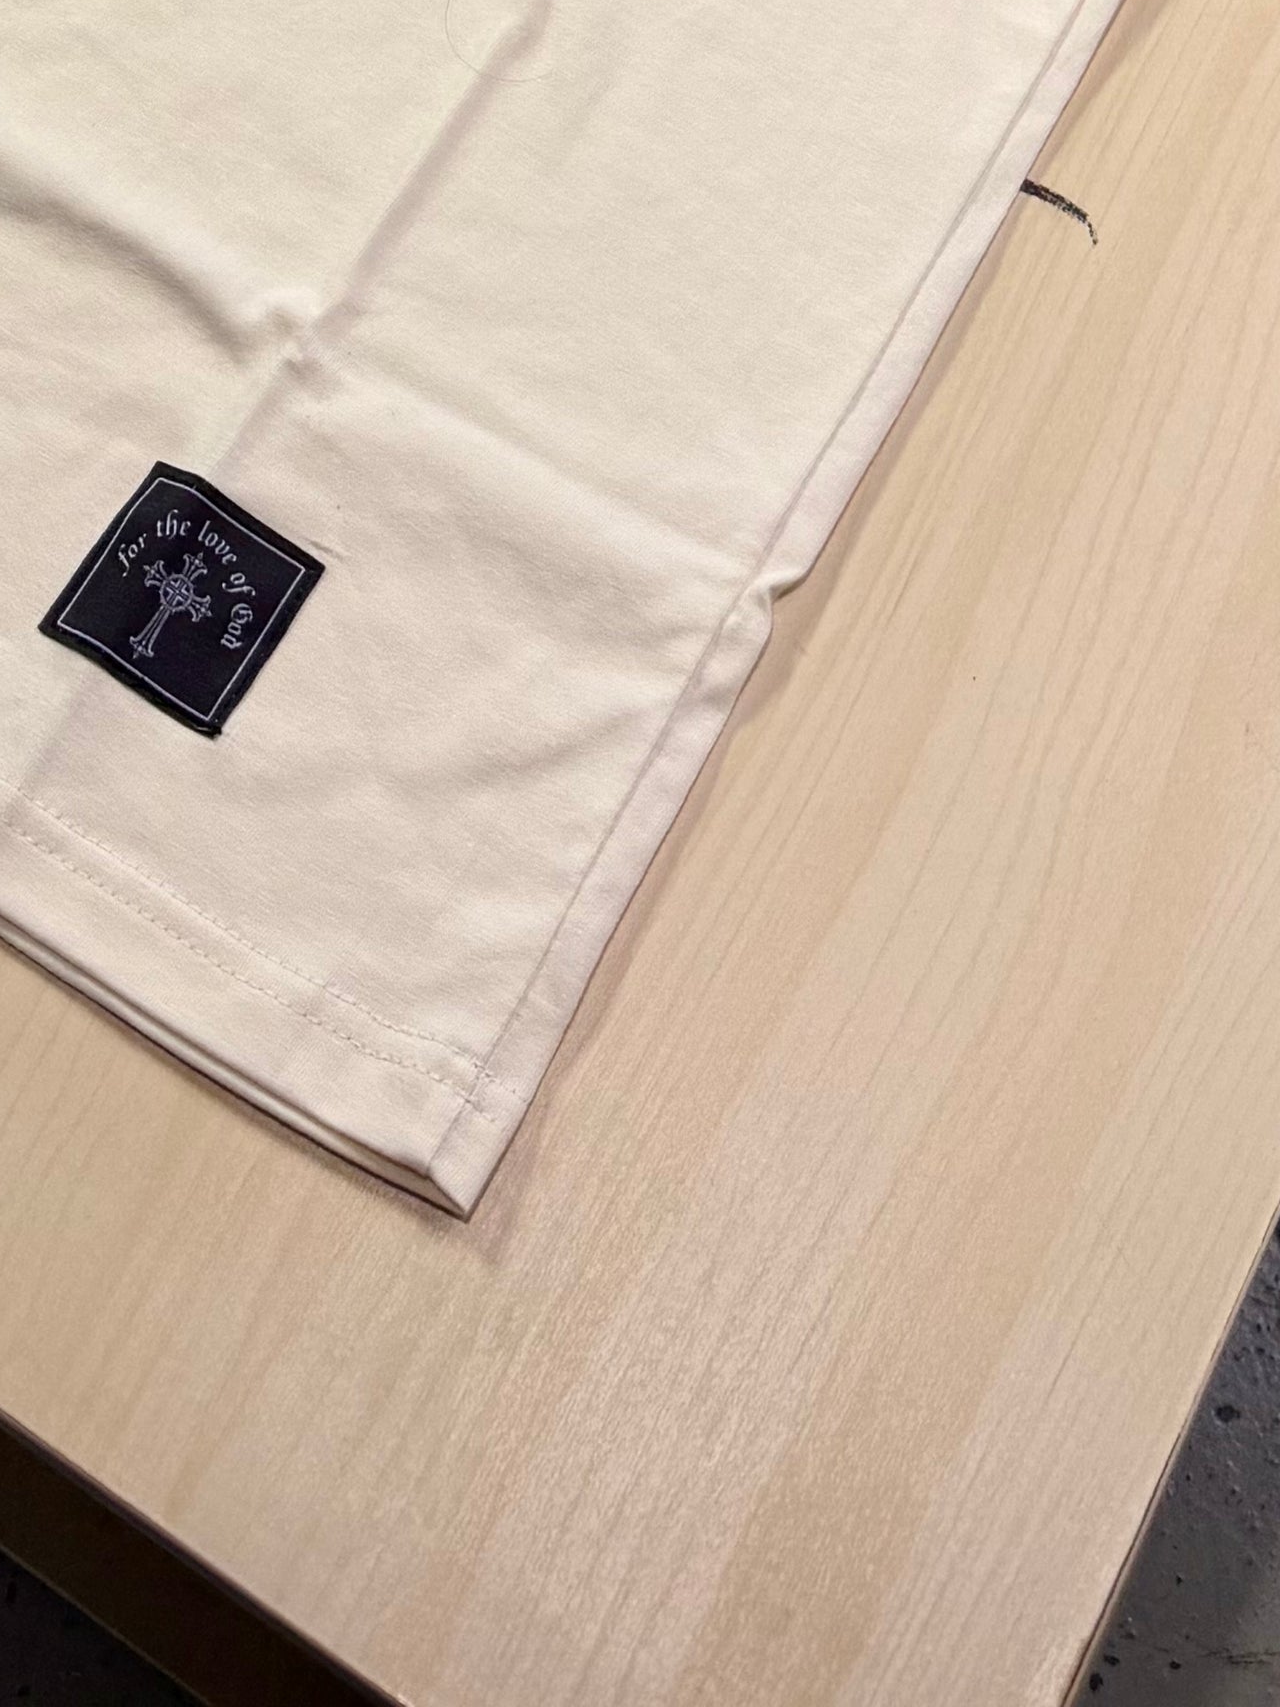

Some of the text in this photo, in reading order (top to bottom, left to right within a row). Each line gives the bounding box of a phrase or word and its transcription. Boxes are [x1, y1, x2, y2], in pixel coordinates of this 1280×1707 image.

[117, 509, 257, 650] for the love of God
